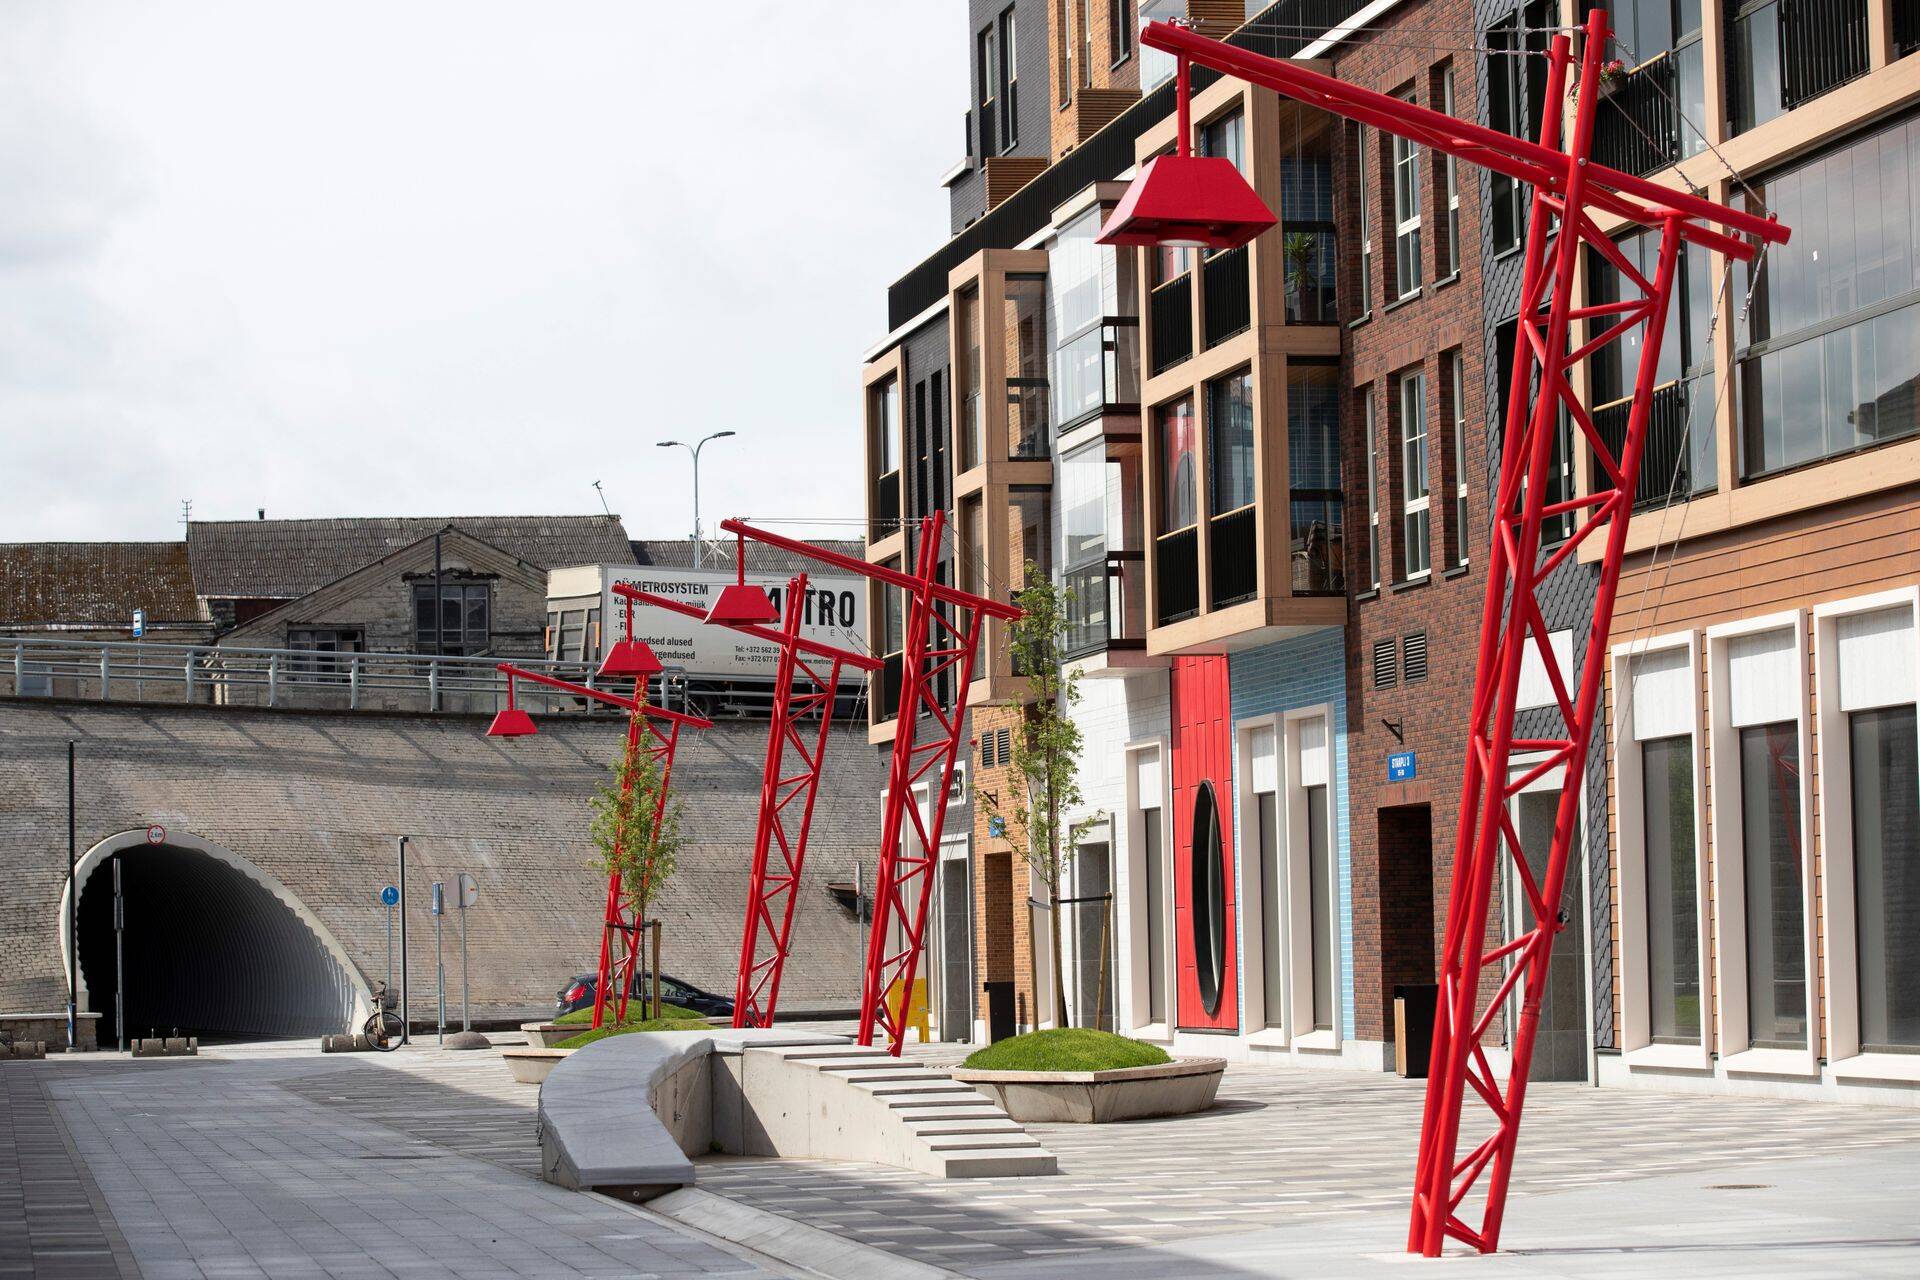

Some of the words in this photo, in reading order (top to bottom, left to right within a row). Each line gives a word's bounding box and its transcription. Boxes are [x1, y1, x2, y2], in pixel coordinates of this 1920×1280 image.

[632, 581, 709, 595] METROSYSTEM
[767, 588, 855, 628] TRO
[667, 637, 693, 647] alused
[652, 650, 696, 660] rgendused
